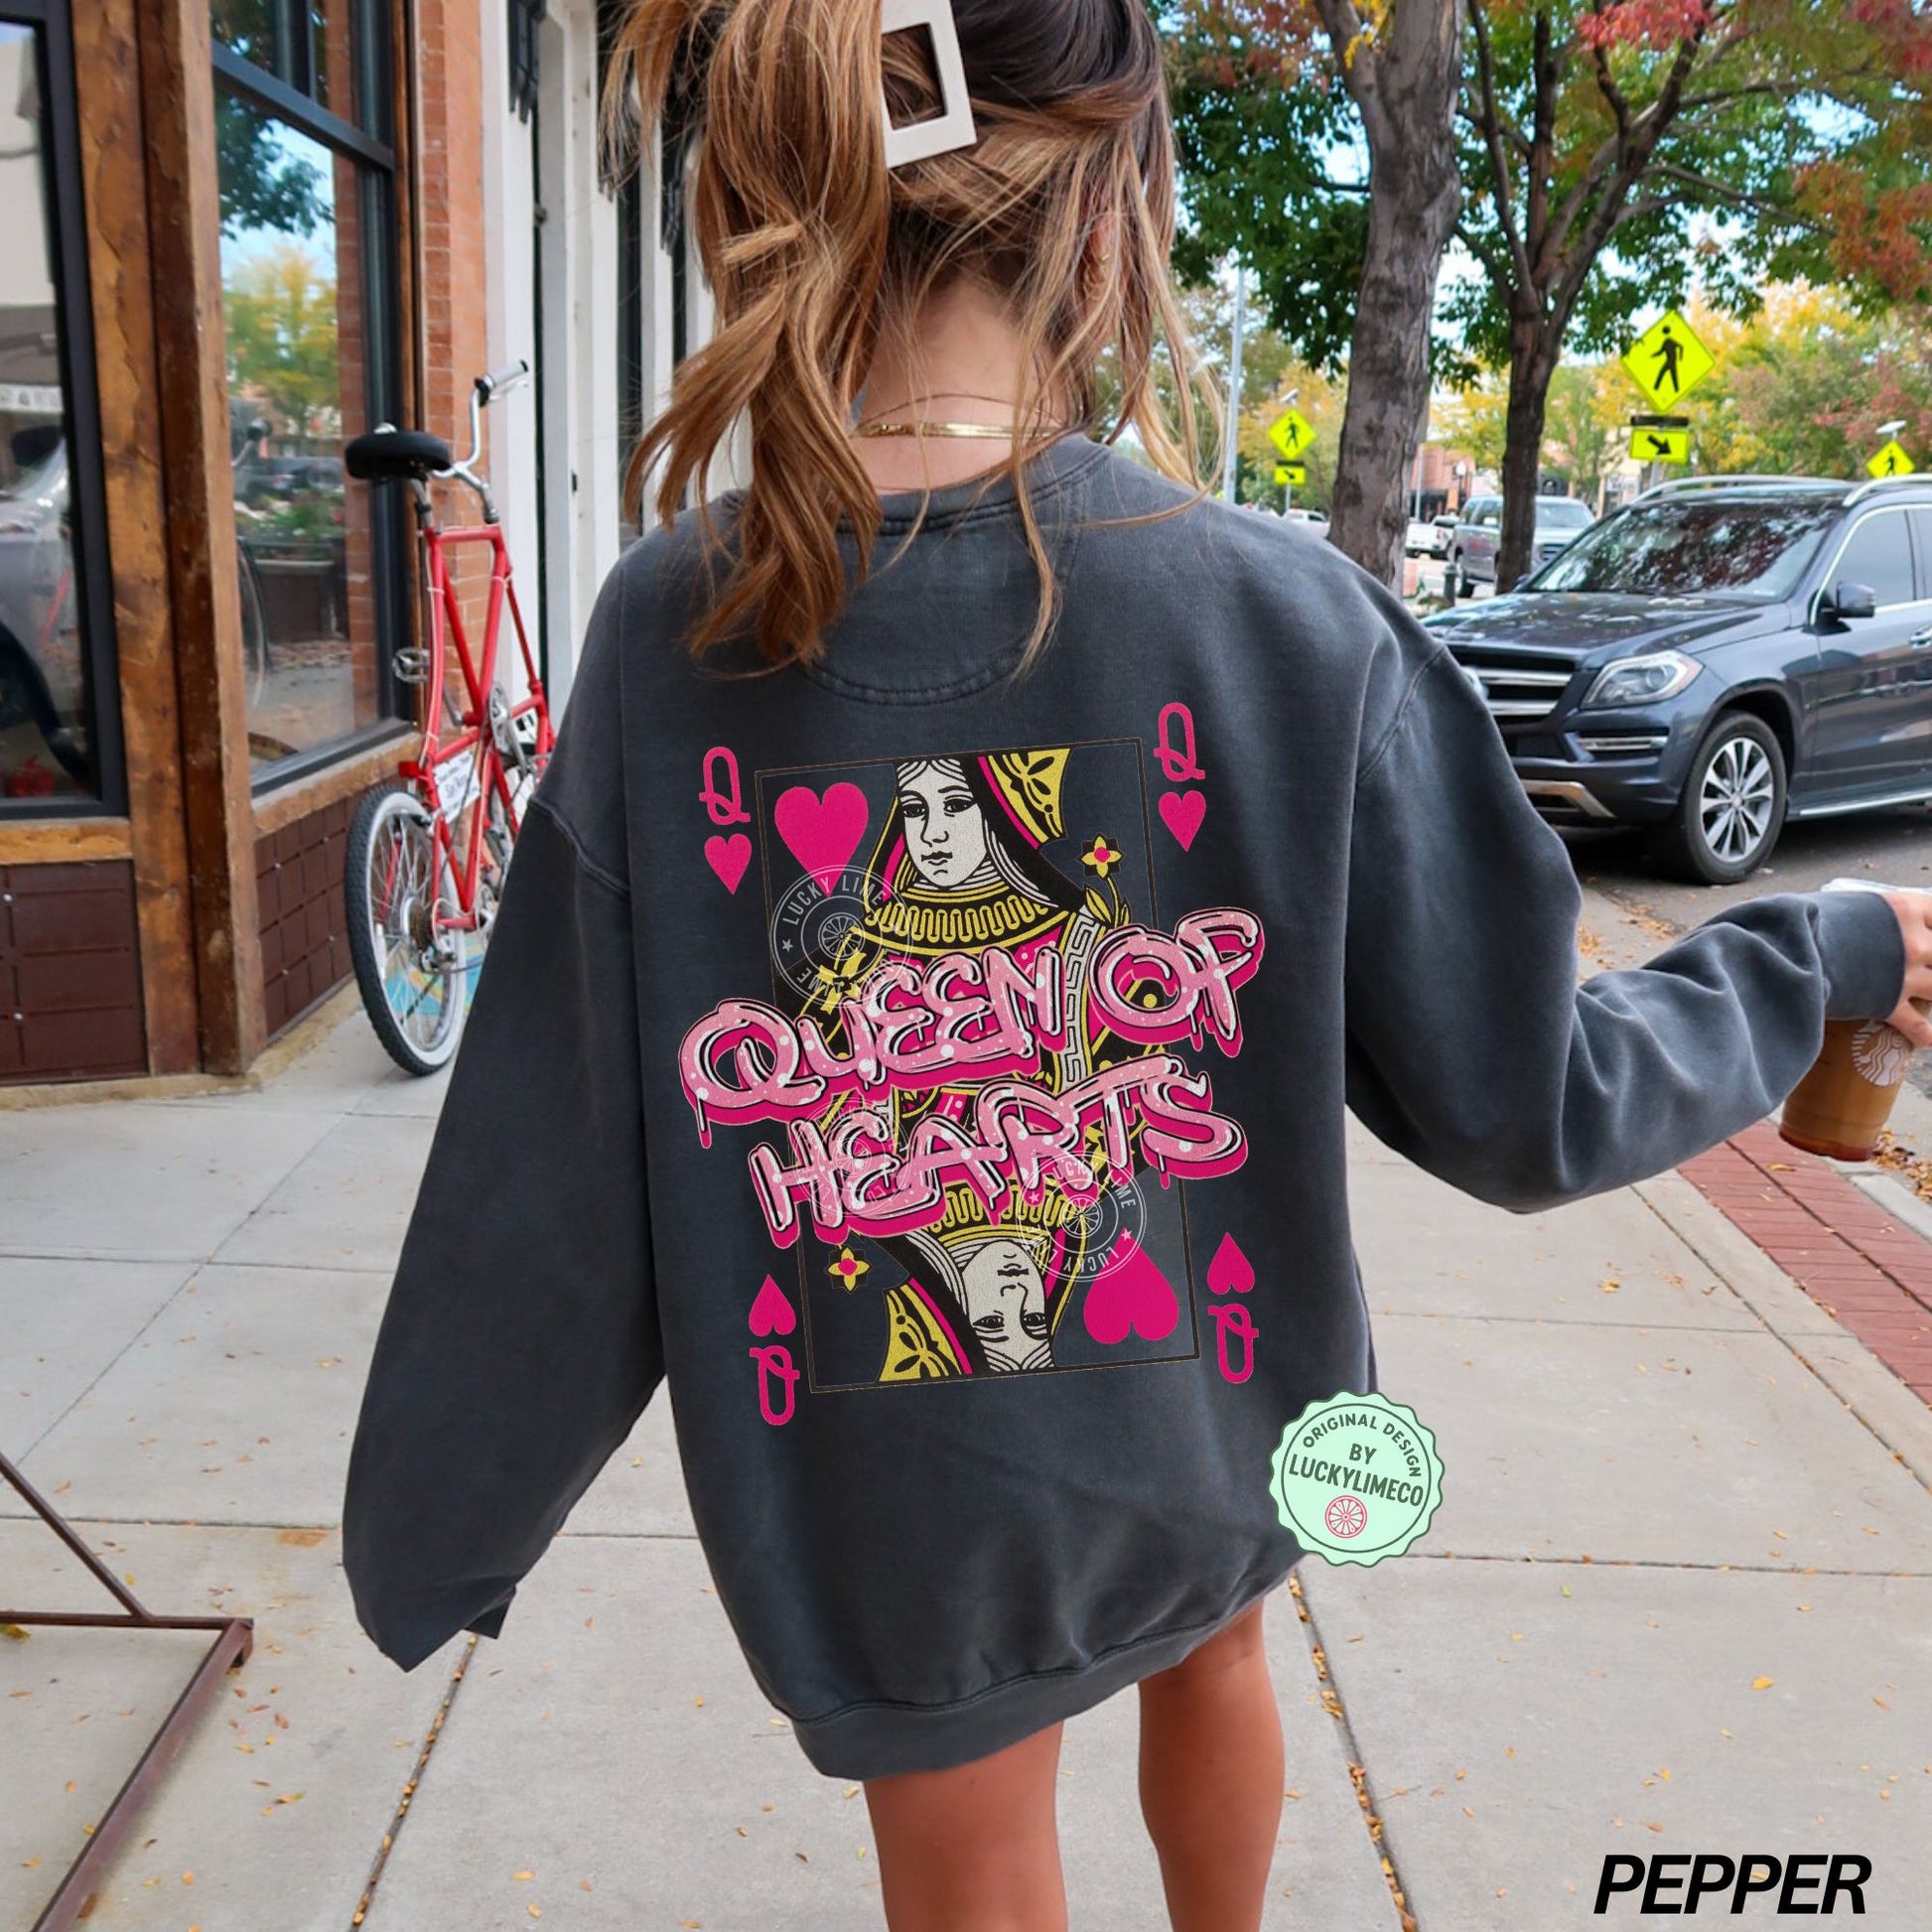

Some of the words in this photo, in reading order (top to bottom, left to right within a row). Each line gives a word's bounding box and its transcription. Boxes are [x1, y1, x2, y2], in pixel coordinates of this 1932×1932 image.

[1153, 702, 1205, 782] Q
[699, 746, 751, 826] Q
[679, 946, 1067, 1149] QUEEN
[1089, 907, 1265, 1058] OF
[748, 1055, 1248, 1249] HEARTS
[1207, 1303, 1260, 1383] Q
[750, 1344, 800, 1426] Q
